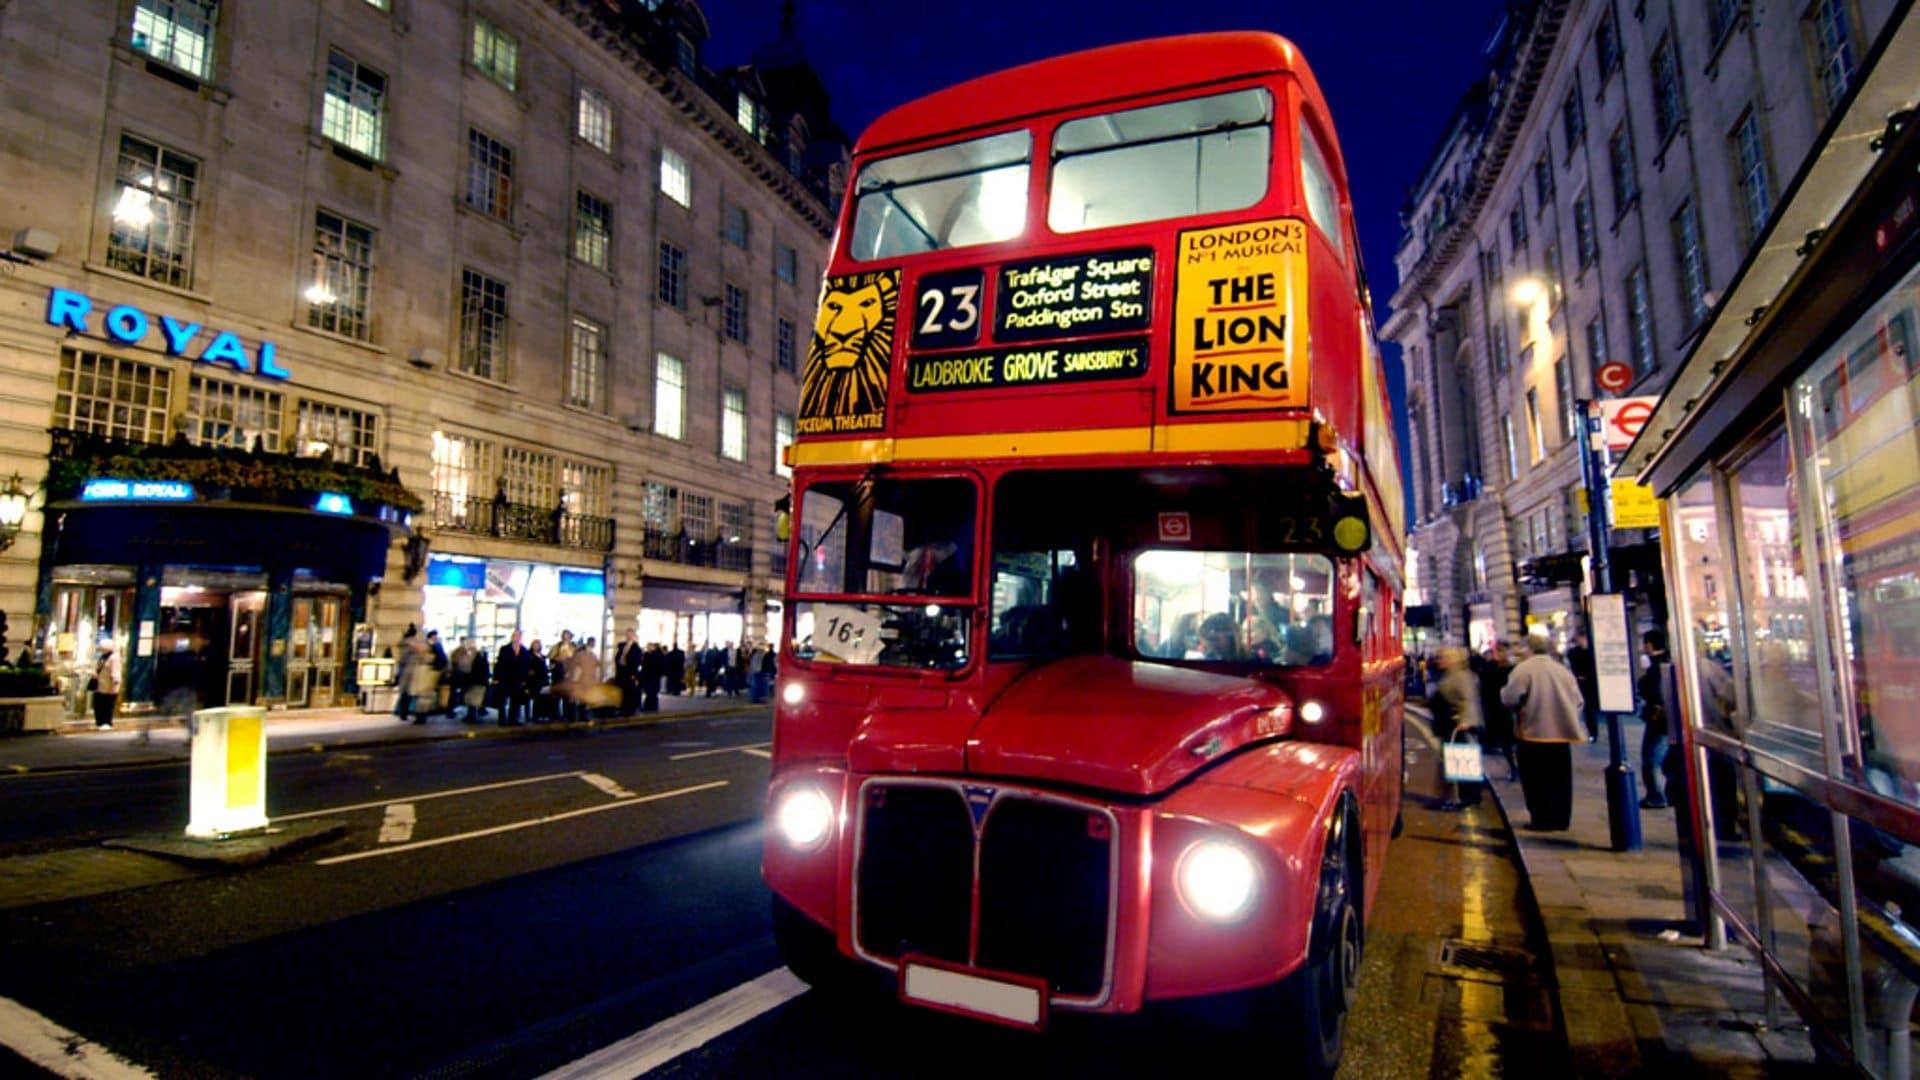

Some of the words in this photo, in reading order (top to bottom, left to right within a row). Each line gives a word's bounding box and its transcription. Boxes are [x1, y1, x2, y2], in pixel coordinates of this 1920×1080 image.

[1189, 225, 1302, 250] LONDON'S
[1223, 241, 1301, 260] MUSICAL
[1005, 264, 1080, 288] Trafalgar
[1086, 257, 1151, 279] Square
[1012, 281, 1075, 309] Oxford
[1080, 279, 1141, 299] Street
[1208, 273, 1275, 305] THE
[919, 285, 979, 334] 23
[1005, 306, 1103, 328] Paddington
[1110, 301, 1142, 318] Stn
[46, 287, 291, 380] ROYAL
[1194, 314, 1286, 350] LION
[913, 356, 994, 387] LADBROKE
[1003, 350, 1058, 381] GROVE
[1063, 348, 1138, 373] SAINSBURY'S
[1191, 361, 1289, 398] KING
[1601, 365, 1624, 387] C
[796, 418, 833, 432] YCEUM
[835, 413, 884, 431] THEATRE
